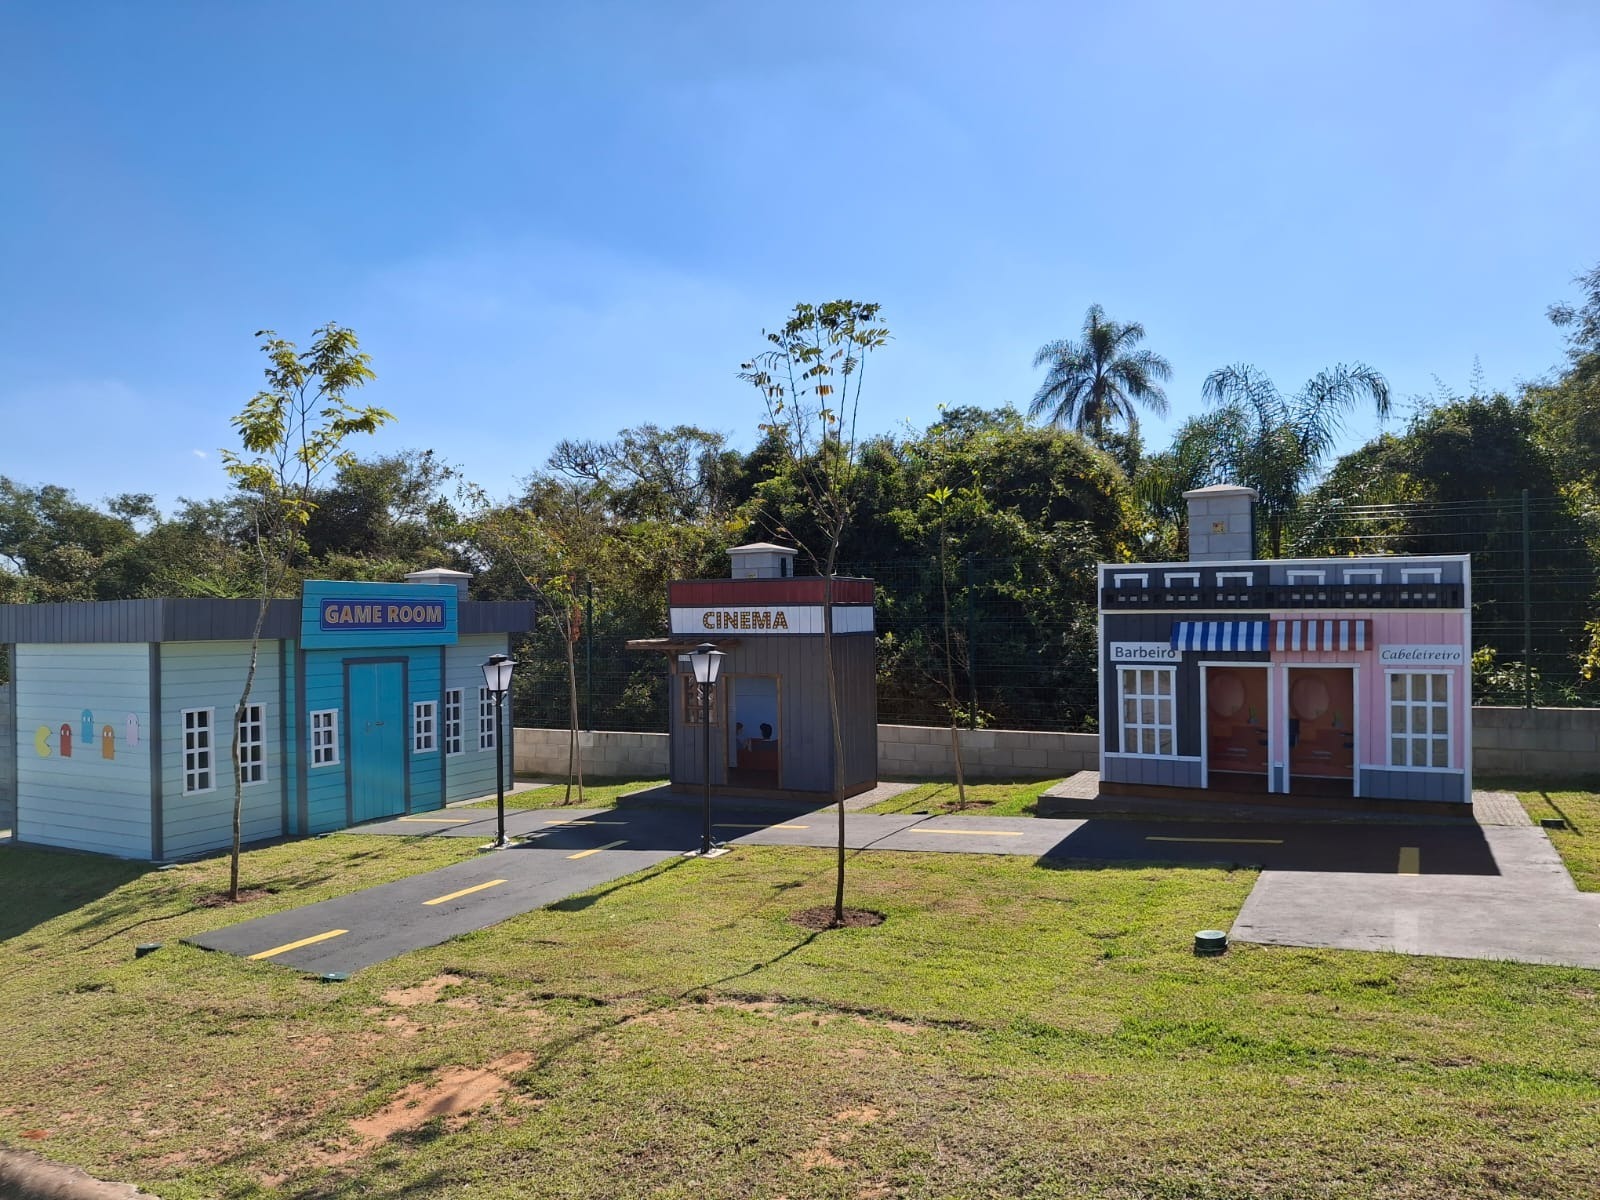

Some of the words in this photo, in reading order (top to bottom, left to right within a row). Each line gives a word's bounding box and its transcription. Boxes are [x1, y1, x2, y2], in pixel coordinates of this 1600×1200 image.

[325, 605, 382, 624] GAME
[387, 605, 442, 623] ROOM
[702, 611, 788, 630] CINEMA
[1115, 646, 1176, 658] Barbeiro
[1381, 649, 1460, 660] Cabeleireiro
